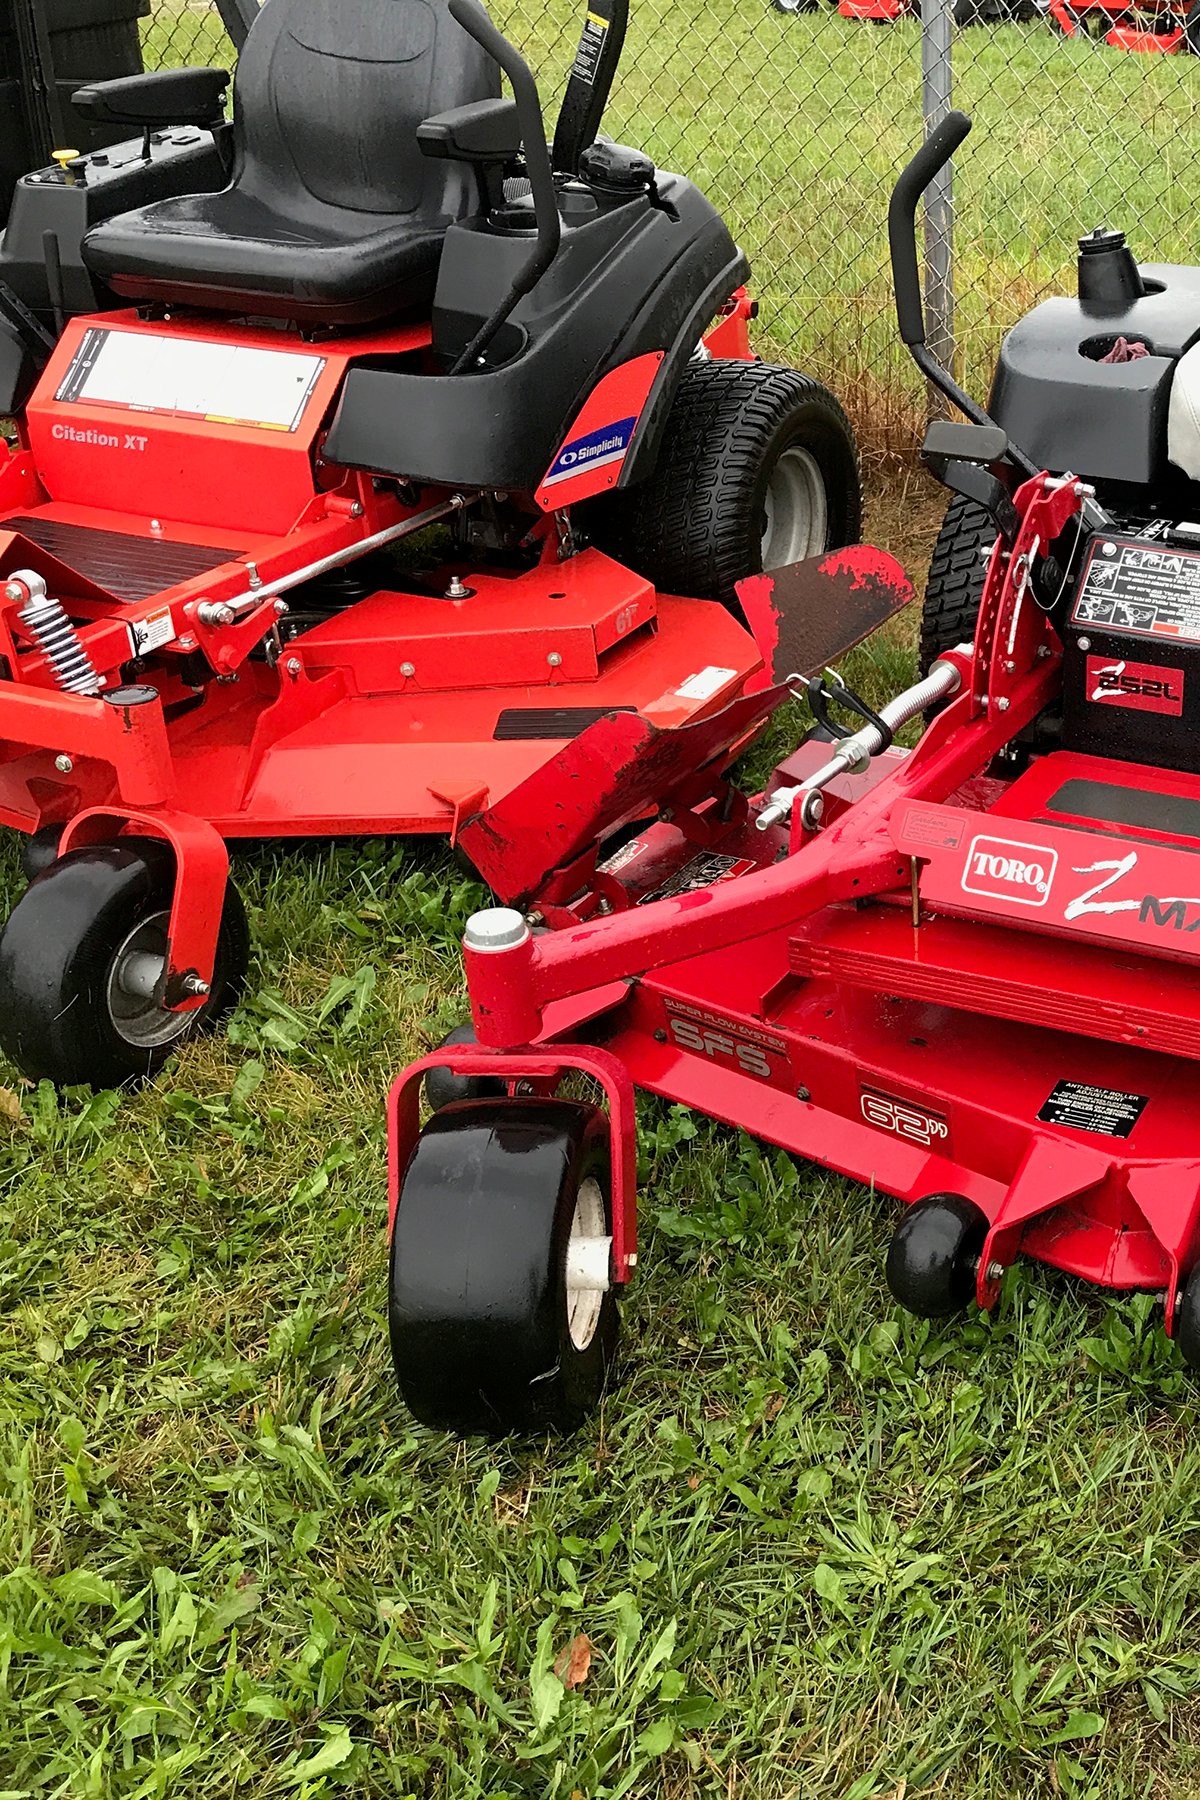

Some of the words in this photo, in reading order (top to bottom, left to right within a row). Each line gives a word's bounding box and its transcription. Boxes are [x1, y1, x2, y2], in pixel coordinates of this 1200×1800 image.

[51, 424, 119, 448] Citation
[123, 433, 148, 452] XT
[577, 436, 623, 460] Simplicity
[973, 852, 1044, 887] TORO
[664, 998, 702, 1019] SUPER
[703, 1013, 737, 1031] FLOW
[670, 1018, 771, 1077] SFS
[1066, 1082, 1108, 1095] ANTI-SCALP
[1109, 1091, 1139, 1101] ROLLER
[1076, 1089, 1124, 1103] ADJUSTMENT
